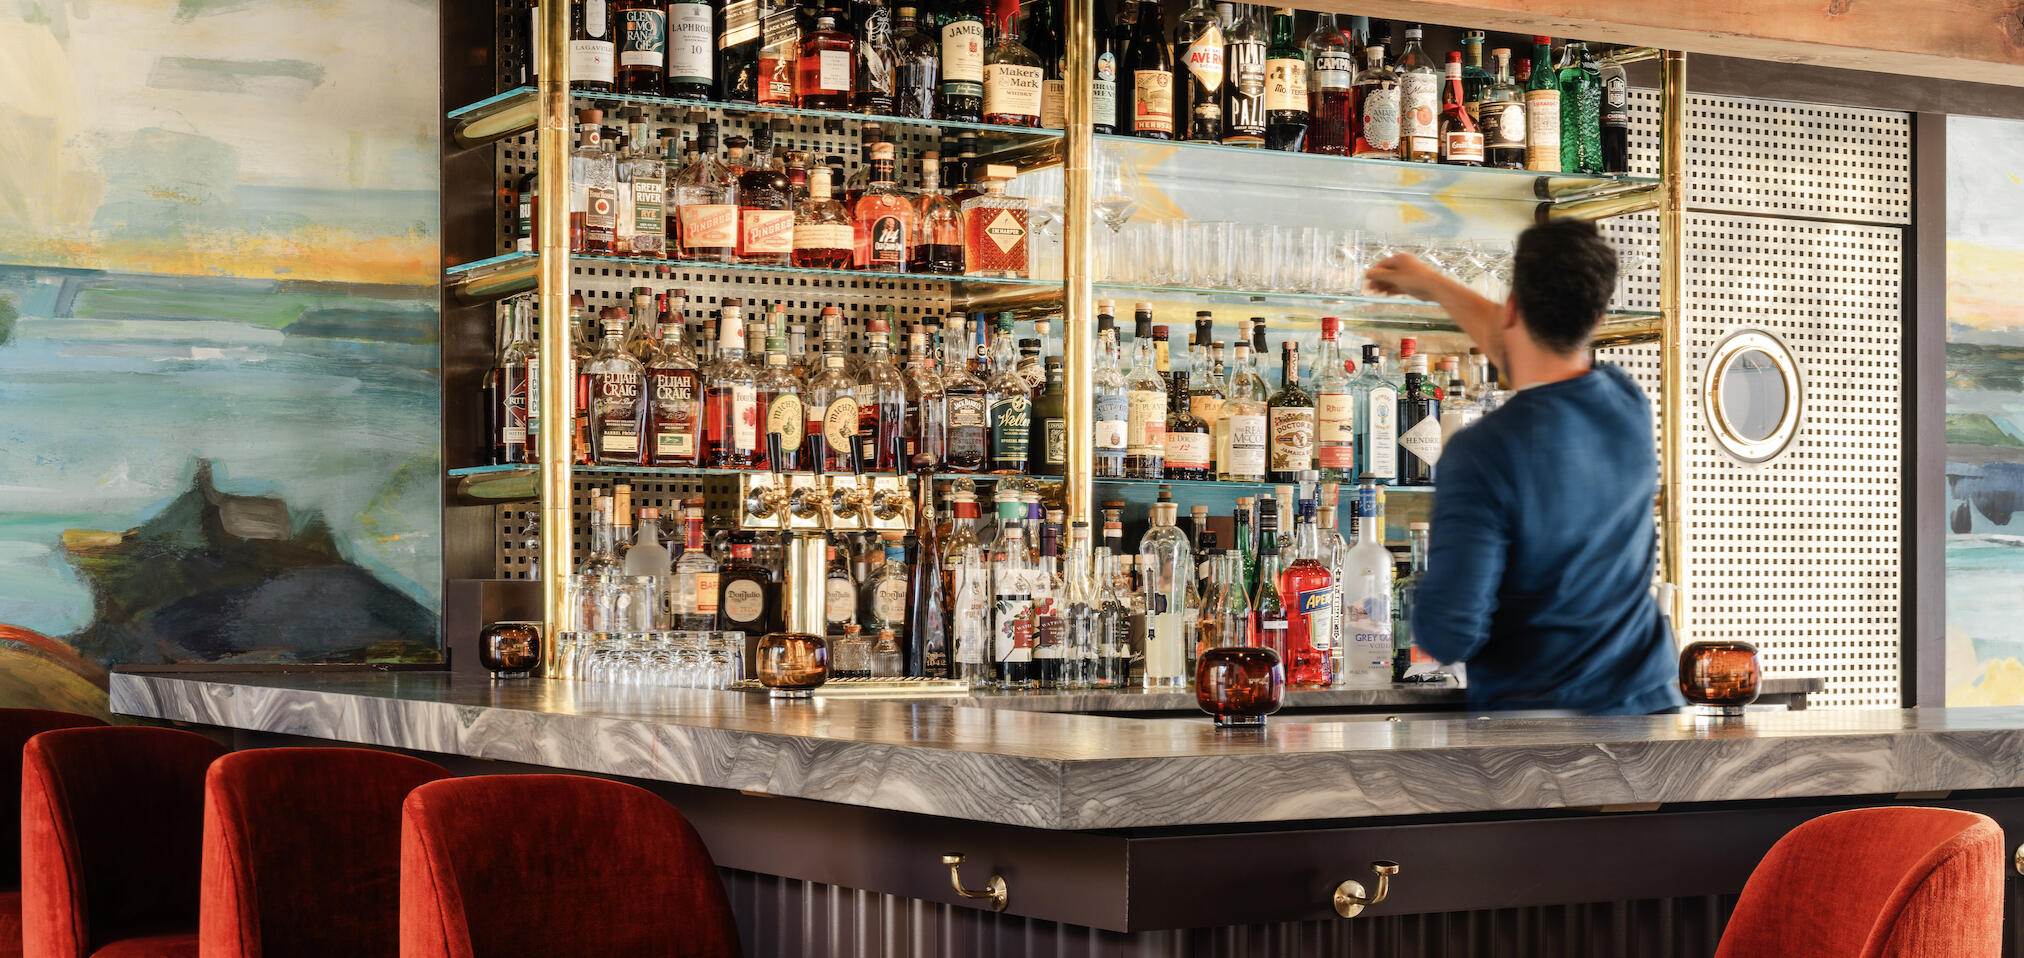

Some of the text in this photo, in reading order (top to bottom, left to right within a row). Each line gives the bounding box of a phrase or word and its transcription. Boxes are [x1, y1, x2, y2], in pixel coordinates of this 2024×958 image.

[626, 11, 654, 22] GLEN
[949, 25, 984, 39] JAMES
[691, 45, 703, 55] 10
[1190, 52, 1223, 65] AVERN
[1317, 57, 1351, 71] CAMPA
[999, 67, 1040, 79] Maker's
[1010, 78, 1039, 89] Mark
[1137, 121, 1171, 131] HERBSA
[635, 182, 662, 193] GREEN
[636, 192, 662, 204] RIVER
[641, 209, 657, 219] RYE
[602, 371, 638, 385] ELIJAH
[656, 374, 692, 389] ELIJAH
[602, 384, 637, 398] CRAIG
[656, 387, 692, 401] CRAIG
[892, 591, 905, 602] Jul
[1355, 633, 1377, 643] GREY
